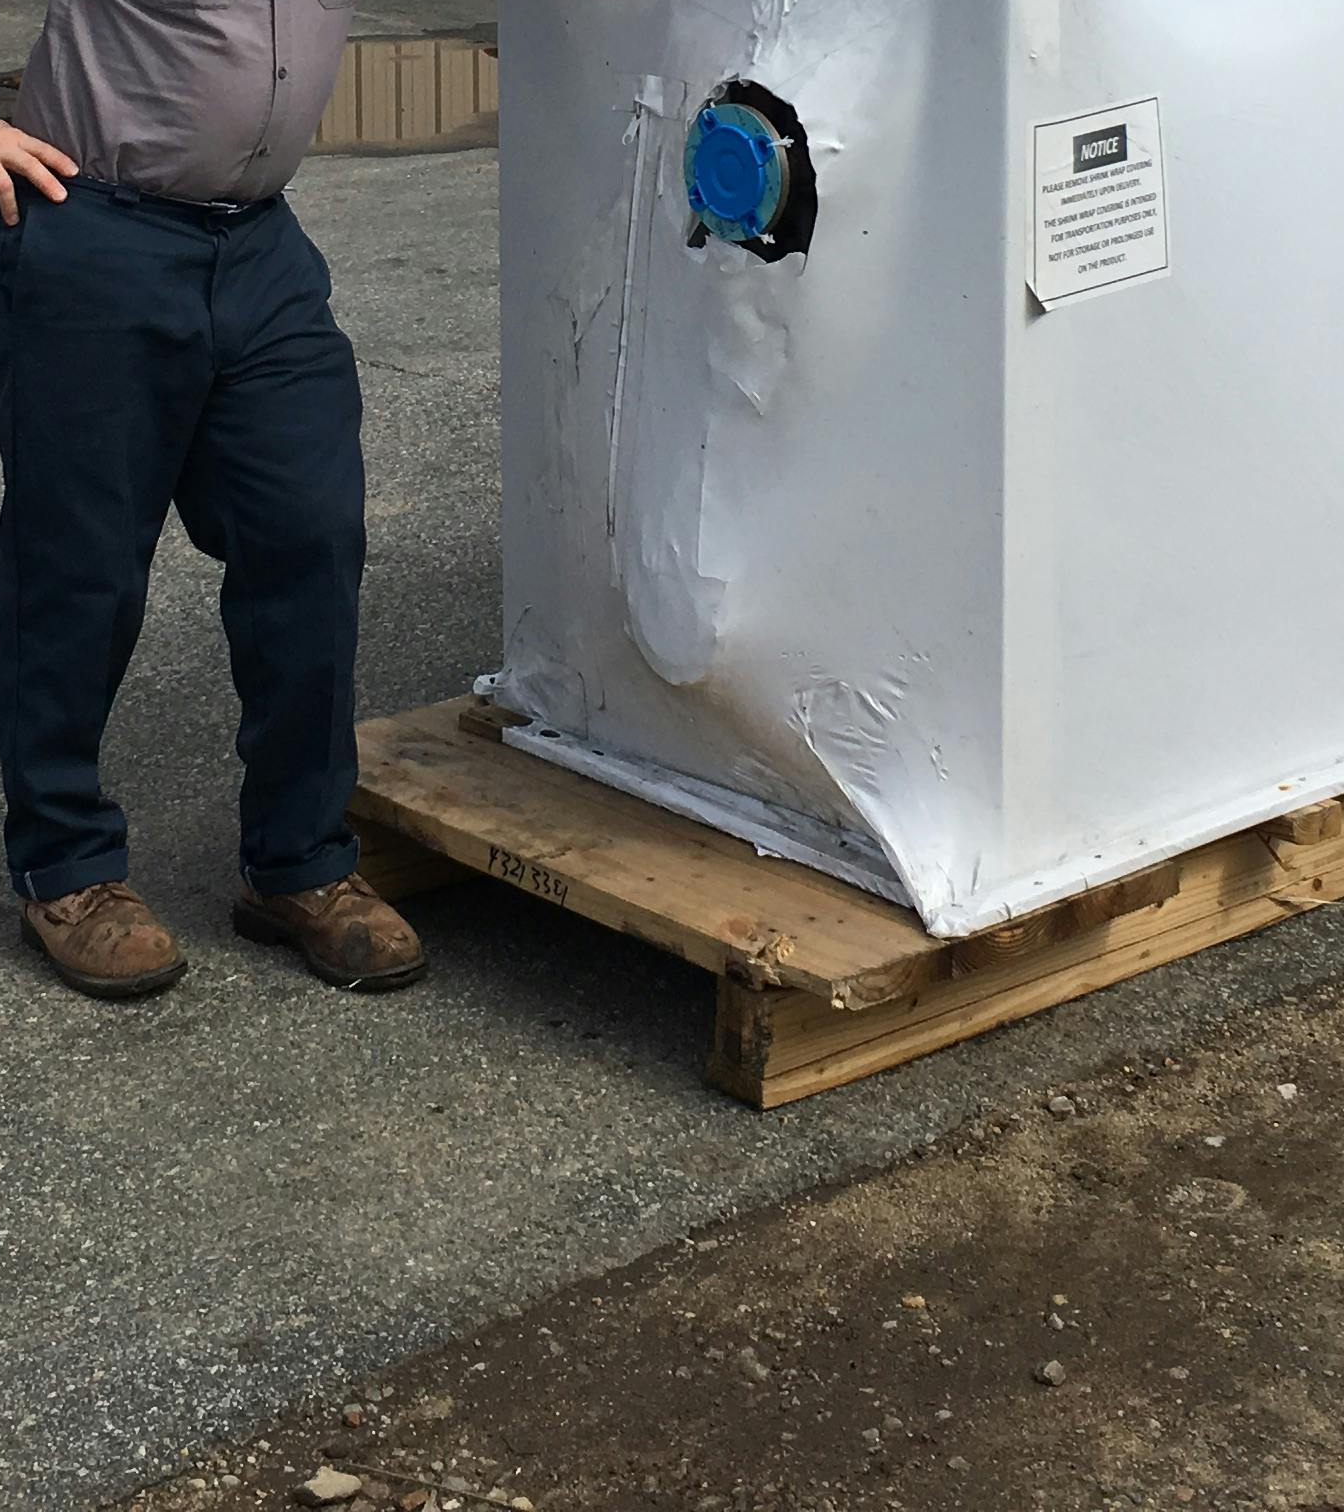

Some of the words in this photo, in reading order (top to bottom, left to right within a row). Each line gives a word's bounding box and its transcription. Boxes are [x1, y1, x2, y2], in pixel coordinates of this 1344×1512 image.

[1080, 136, 1119, 161] NOTICE
[1042, 181, 1064, 194] PLEASE
[1065, 176, 1089, 188] REMOVE
[1090, 170, 1109, 183] SHRINK
[1110, 166, 1126, 177] WRAP
[1127, 159, 1152, 173] COVERING
[1100, 185, 1115, 196] UPON
[1044, 219, 1056, 229] THE
[1057, 213, 1077, 225] SHRINK
[1079, 208, 1096, 220] WRAP
[1096, 201, 1124, 215] COVERING
[1131, 192, 1157, 206] INTENDED
[1051, 233, 1064, 243] FOR
[1064, 220, 1114, 240] TRANSPORTATION
[1114, 212, 1141, 226] PURPOSES
[1048, 252, 1062, 262] NOT
[1063, 248, 1075, 259] FOR
[1075, 241, 1101, 256] STORAGE
[1101, 239, 1110, 248] OR
[1110, 230, 1144, 245] PROLONGED
[1144, 226, 1154, 237] USE
[1077, 264, 1087, 274] ON
[1088, 260, 1098, 270] THE
